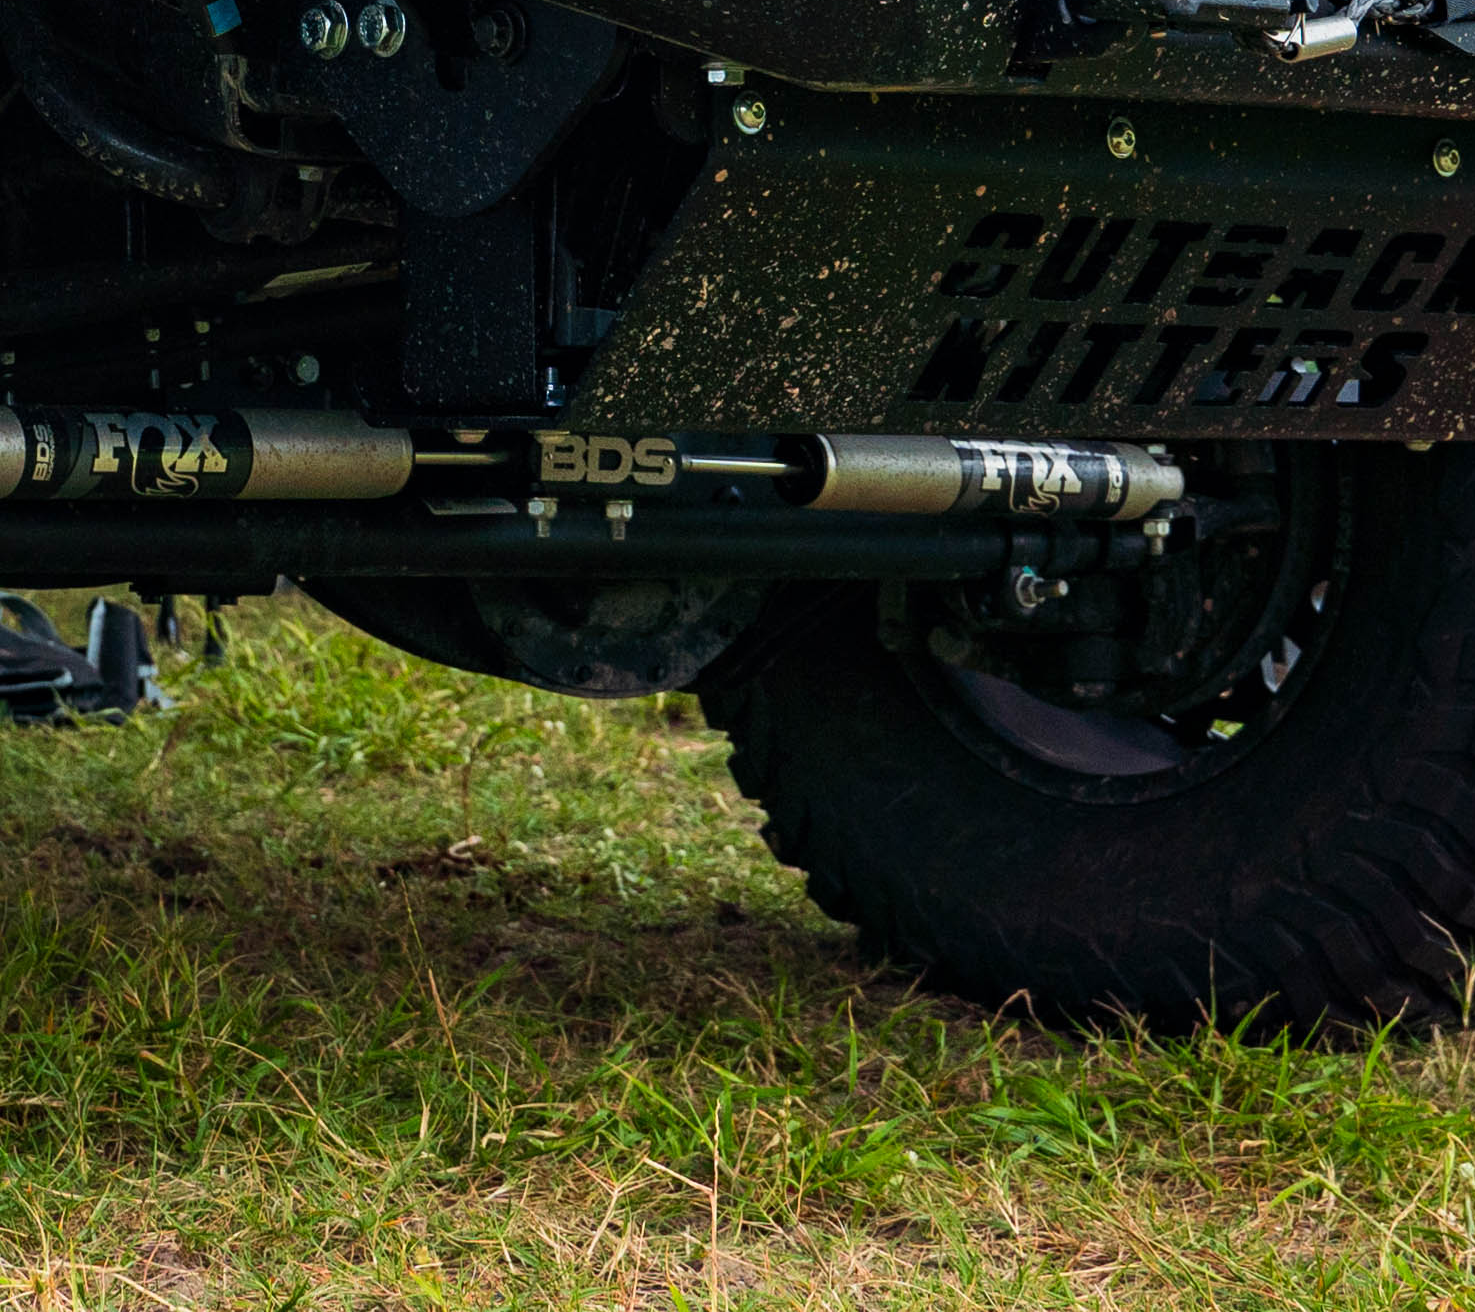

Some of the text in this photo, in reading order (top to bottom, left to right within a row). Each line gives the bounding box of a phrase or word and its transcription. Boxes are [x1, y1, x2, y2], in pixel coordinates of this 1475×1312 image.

[906, 318, 1430, 408] KITTERS
[32, 424, 47, 481] BDS
[83, 411, 228, 498] FOX
[540, 434, 677, 486] BDS
[968, 440, 1082, 515] FOX
